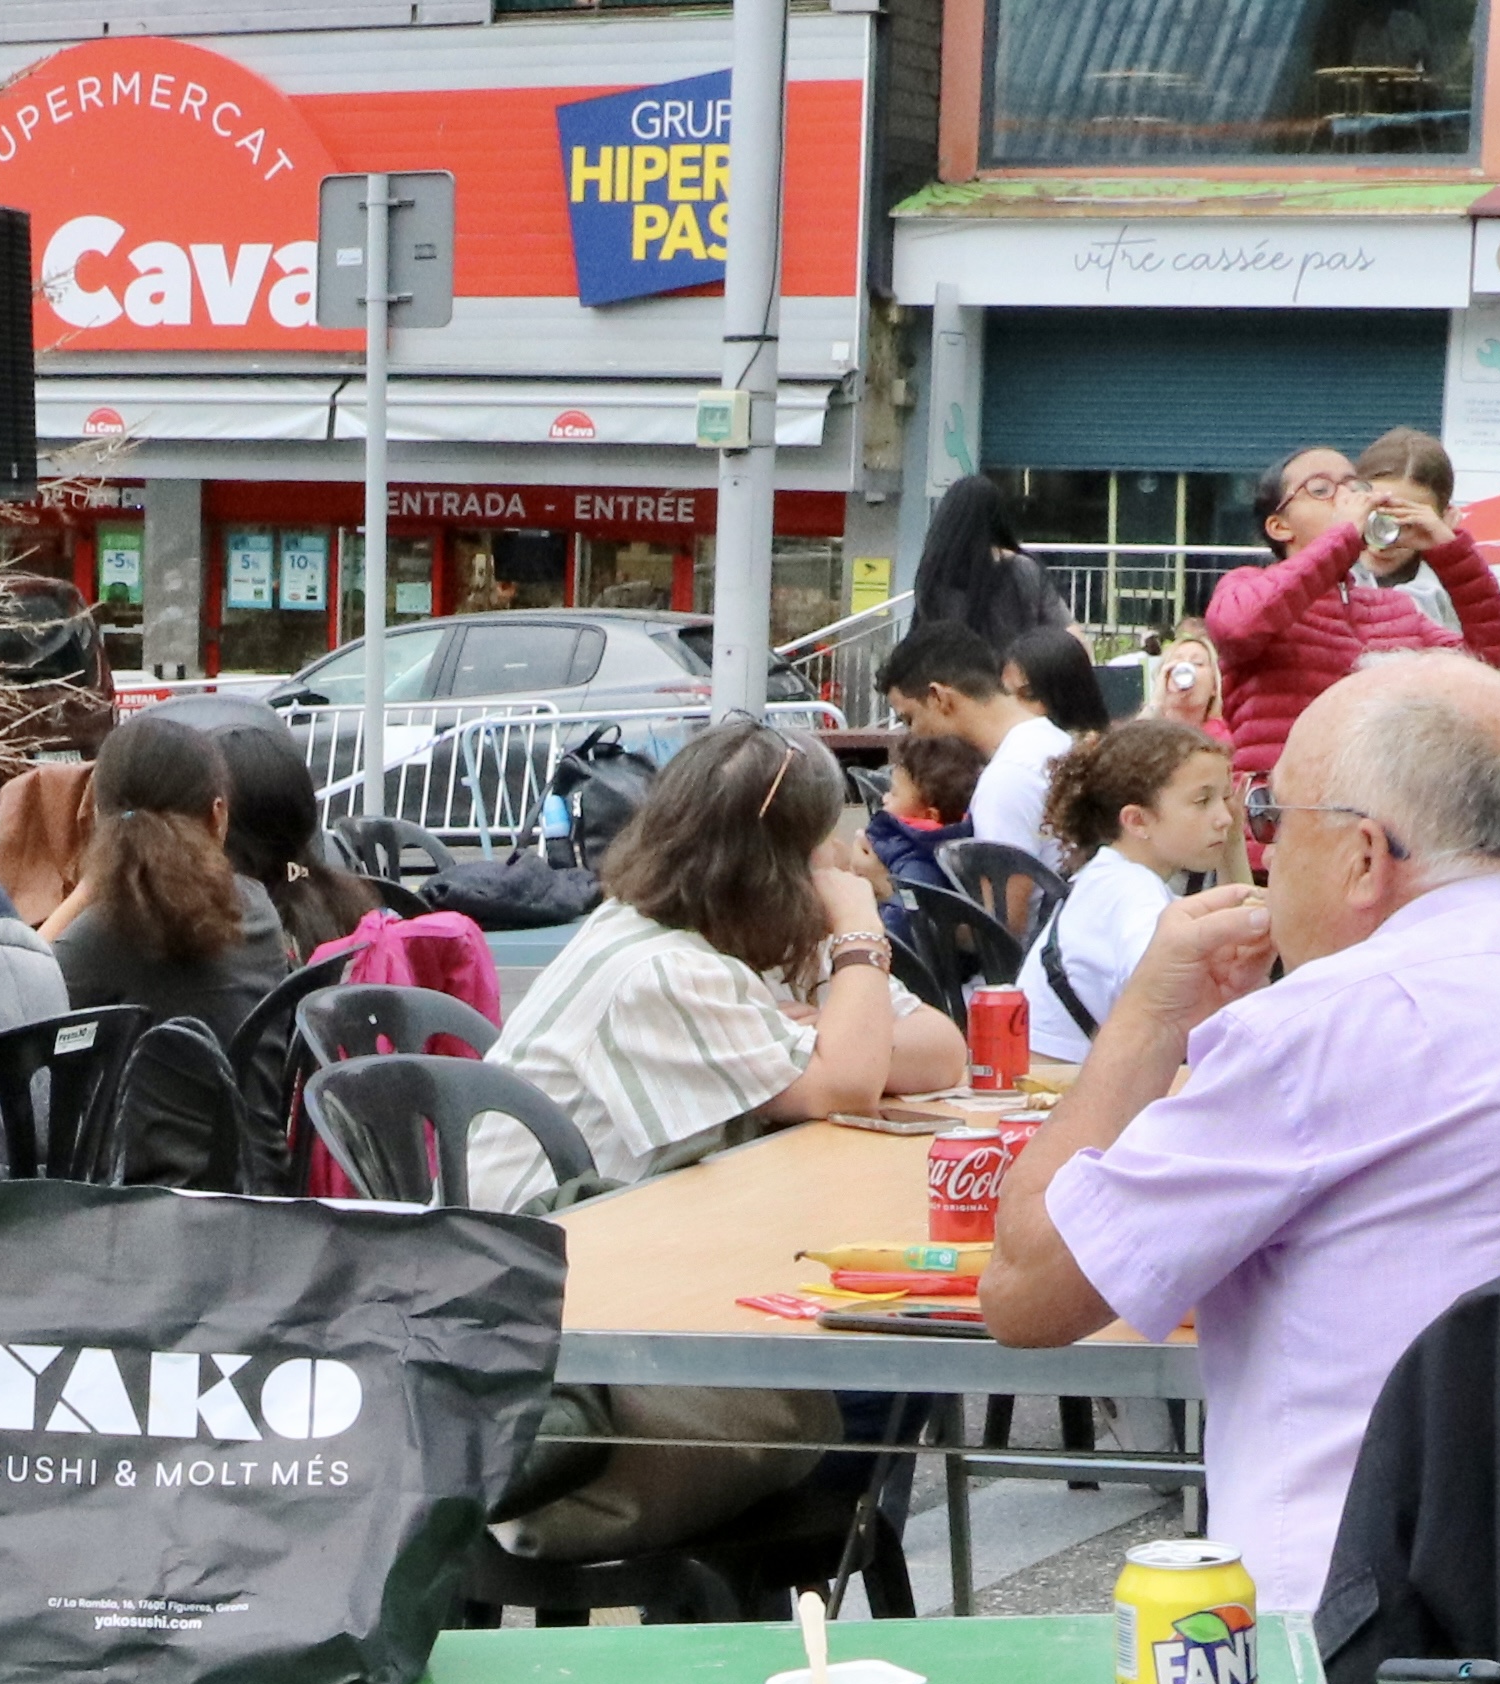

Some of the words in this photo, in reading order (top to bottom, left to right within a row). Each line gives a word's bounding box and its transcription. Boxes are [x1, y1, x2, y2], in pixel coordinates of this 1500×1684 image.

[569, 143, 730, 204] HIPER
[41, 214, 318, 329] Cava
[1074, 224, 1165, 293] vitre
[1171, 238, 1294, 272] cassée
[1292, 246, 1376, 303] pas
[98, 421, 123, 433] Cava
[551, 424, 563, 437] la
[564, 424, 595, 438] Cava
[386, 491, 527, 519] ENTRADA
[574, 489, 696, 523] ENTRÉE
[114, 1459, 138, 1487] &
[155, 1460, 259, 1487] MOLT
[271, 1453, 350, 1487] MÉS
[47, 1597, 62, 1609] C/
[63, 1597, 77, 1608] La
[78, 1598, 120, 1611] Rambla,
[168, 1601, 214, 1614] Figueres,
[215, 1602, 249, 1613] Girona
[94, 1613, 203, 1631] yakosushi.com
